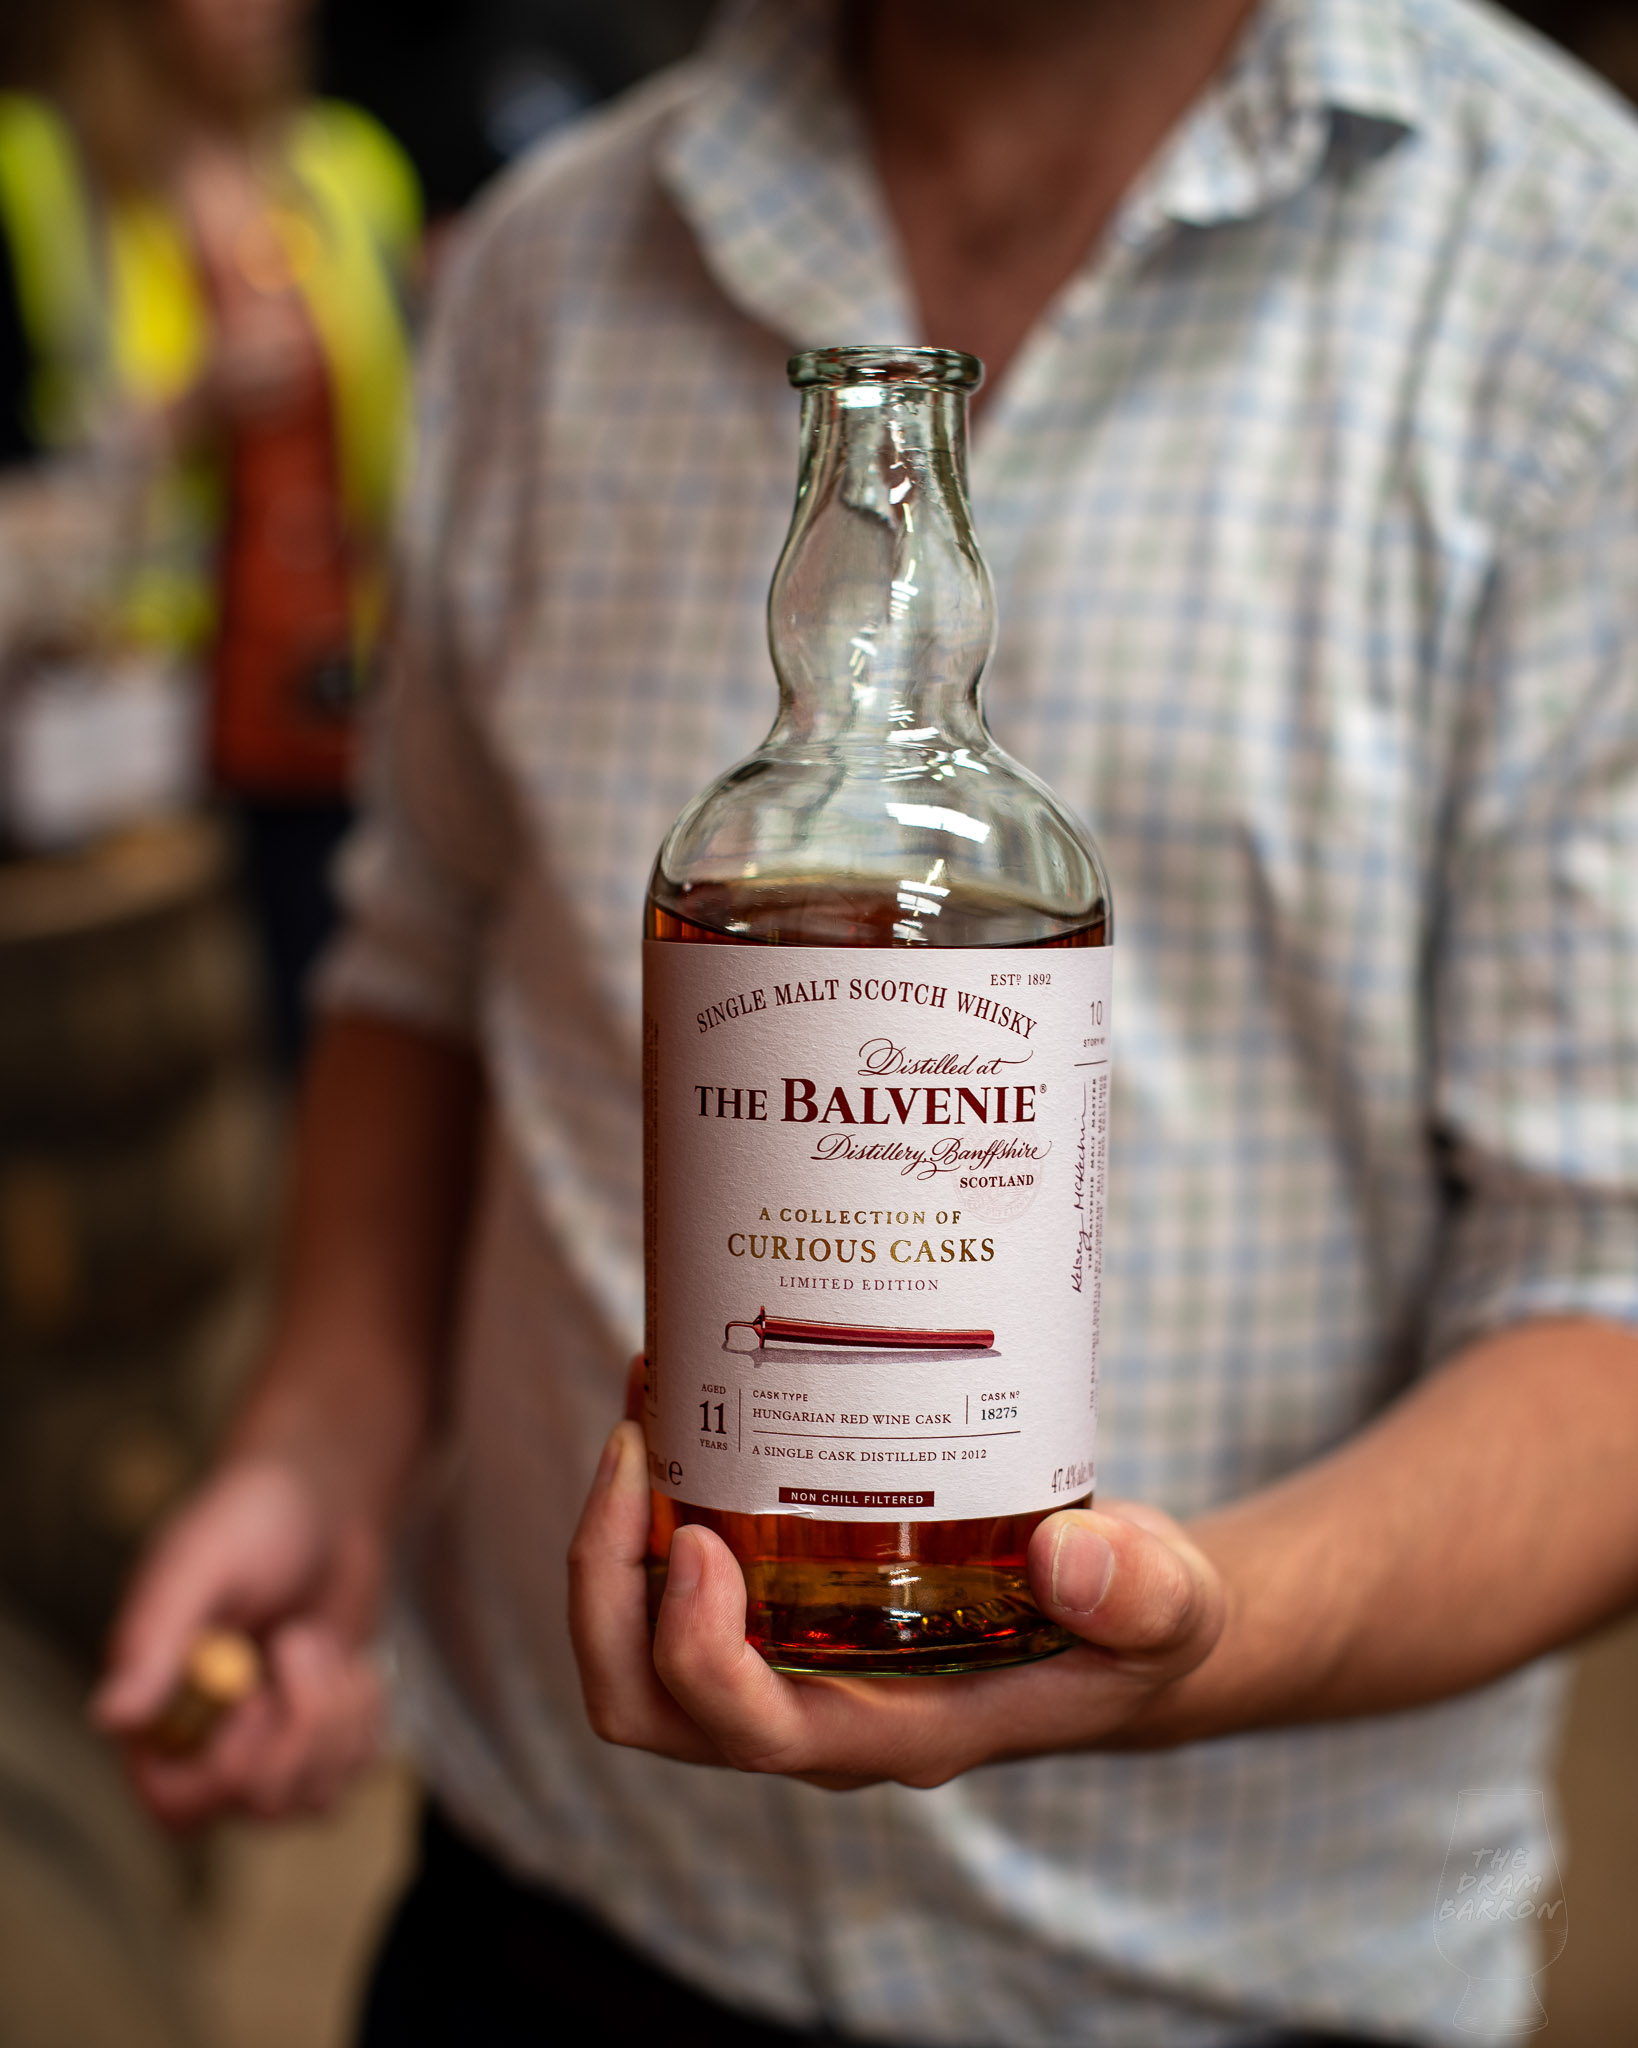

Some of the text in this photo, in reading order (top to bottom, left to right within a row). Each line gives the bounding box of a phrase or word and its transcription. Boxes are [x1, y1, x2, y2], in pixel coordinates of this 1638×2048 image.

[1028, 973, 1051, 985] 1892
[696, 978, 1037, 1039] SINGLE MALT SCOTCH WHISKY
[1090, 1000, 1103, 1026] 10
[857, 1038, 1033, 1076] Distilled at
[695, 1085, 768, 1121] THE
[930, 1137, 1052, 1170] Banffshire
[959, 1175, 1034, 1189] SCOTLAND
[759, 1207, 962, 1225] A COLLECTION OF
[727, 1233, 995, 1264] CURIOUS CASKS
[1071, 1213, 1092, 1293] Kelsey
[779, 1276, 939, 1291] LIMITED EDITION
[701, 1383, 726, 1395] AGED
[753, 1390, 809, 1402] CASK TYPE
[981, 1392, 1006, 1402] CASK
[699, 1400, 727, 1435] 11
[752, 1408, 952, 1425] HUNGARIAN RED WINE CASK
[981, 1406, 1017, 1421] 18275
[700, 1439, 728, 1451] YEARS
[752, 1445, 987, 1462] A SINGLE CASK DISTILLED IN 2012
[1051, 1464, 1077, 1493] 47.4%
[791, 1492, 924, 1504] NON CHILL FILTERED
